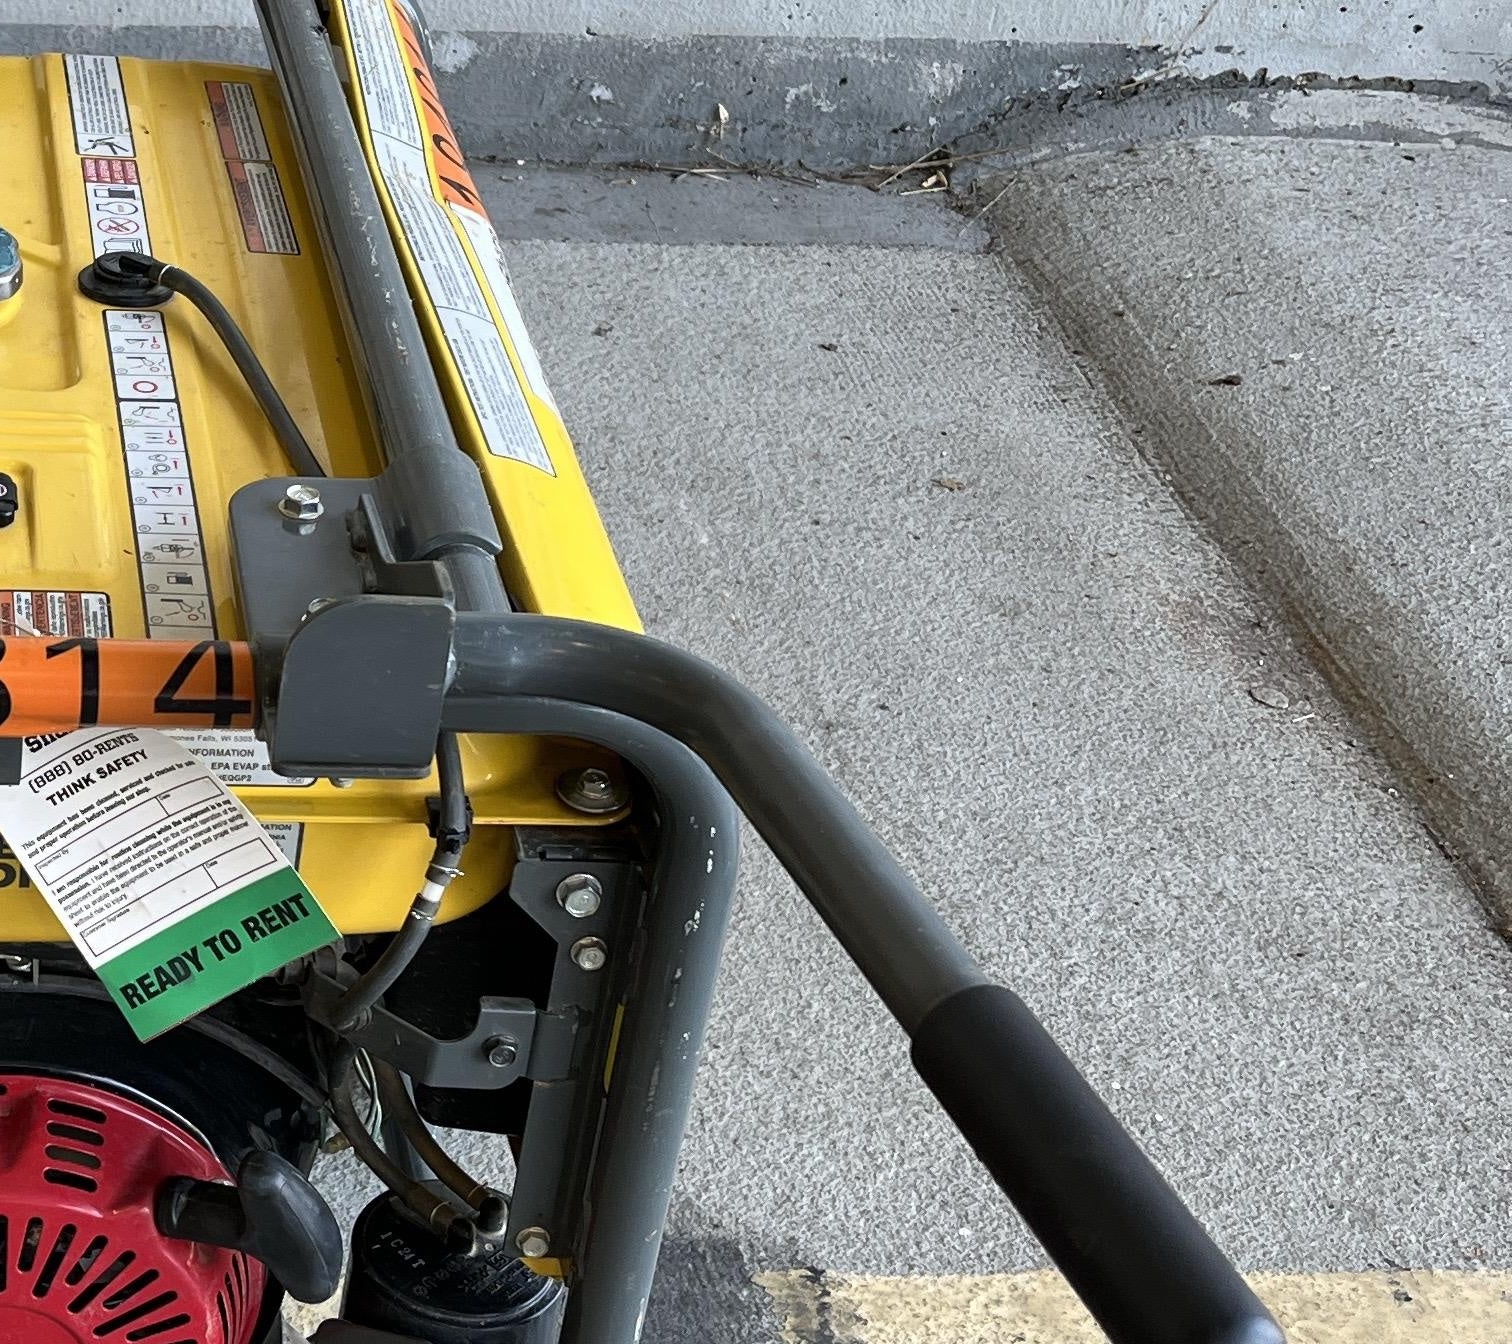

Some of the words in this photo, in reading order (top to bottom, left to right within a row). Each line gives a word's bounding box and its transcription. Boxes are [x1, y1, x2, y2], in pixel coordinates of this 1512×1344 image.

[27, 762, 72, 794] (888)
[71, 732, 139, 767] 80-RENTS
[45, 774, 98, 808] THINK
[94, 745, 149, 781] SAFETY
[233, 762, 258, 770] EVAP
[21, 839, 34, 849] This
[34, 820, 67, 841] equipment
[38, 837, 59, 851] proper
[119, 946, 205, 1009] READY
[202, 929, 243, 962] TO
[241, 893, 311, 944] RENT
